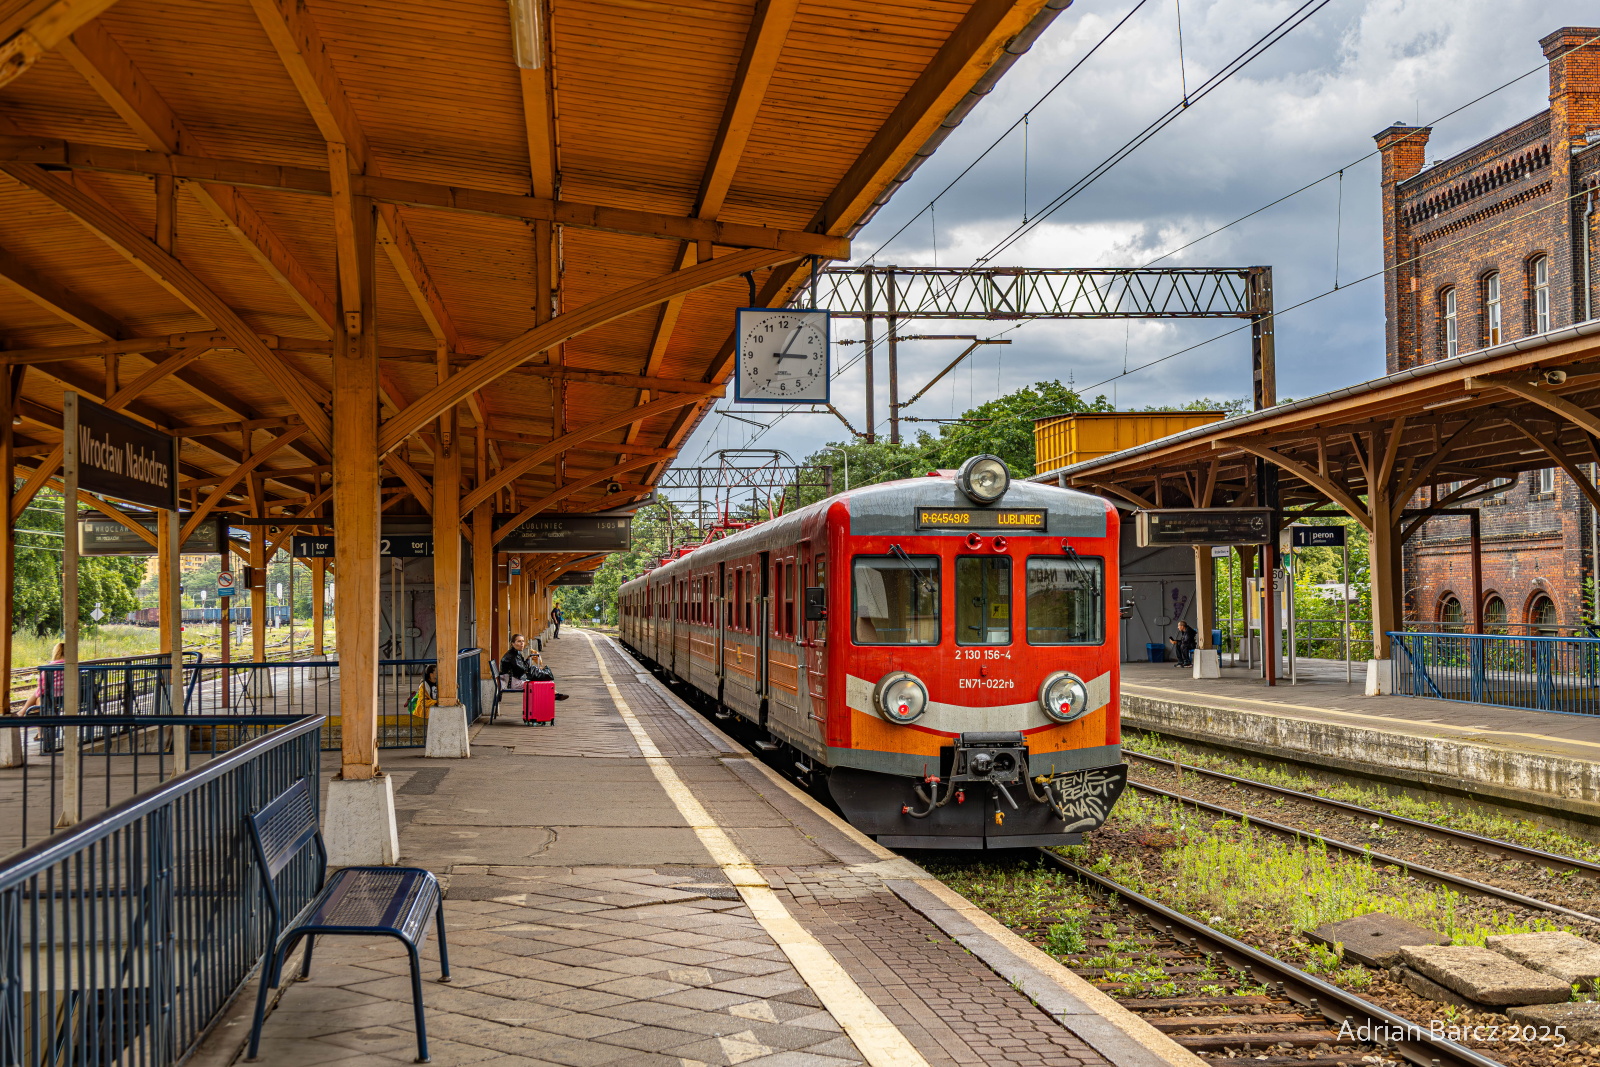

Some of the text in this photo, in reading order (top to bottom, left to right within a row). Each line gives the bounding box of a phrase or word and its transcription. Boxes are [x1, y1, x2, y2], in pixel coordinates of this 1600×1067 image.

[753, 335, 763, 343] 10
[808, 336, 813, 344] 2
[748, 351, 753, 359] 9
[813, 352, 818, 360] 3
[753, 367, 758, 375] 8
[807, 368, 813, 376] 4
[766, 379, 771, 387] 7
[79, 424, 168, 489] Wrocław Nadodrze
[922, 513, 1042, 525] R-64549/8 LUBLINIEC
[521, 522, 563, 530] LUBLINIEC
[1299, 531, 1334, 544] 1 peron
[300, 542, 307, 556] 1
[316, 542, 329, 550] tor
[380, 539, 391, 555] 2
[411, 541, 424, 549] tor
[955, 650, 1012, 660] 2 130 156-4
[959, 678, 1015, 689] EN71-022rb
